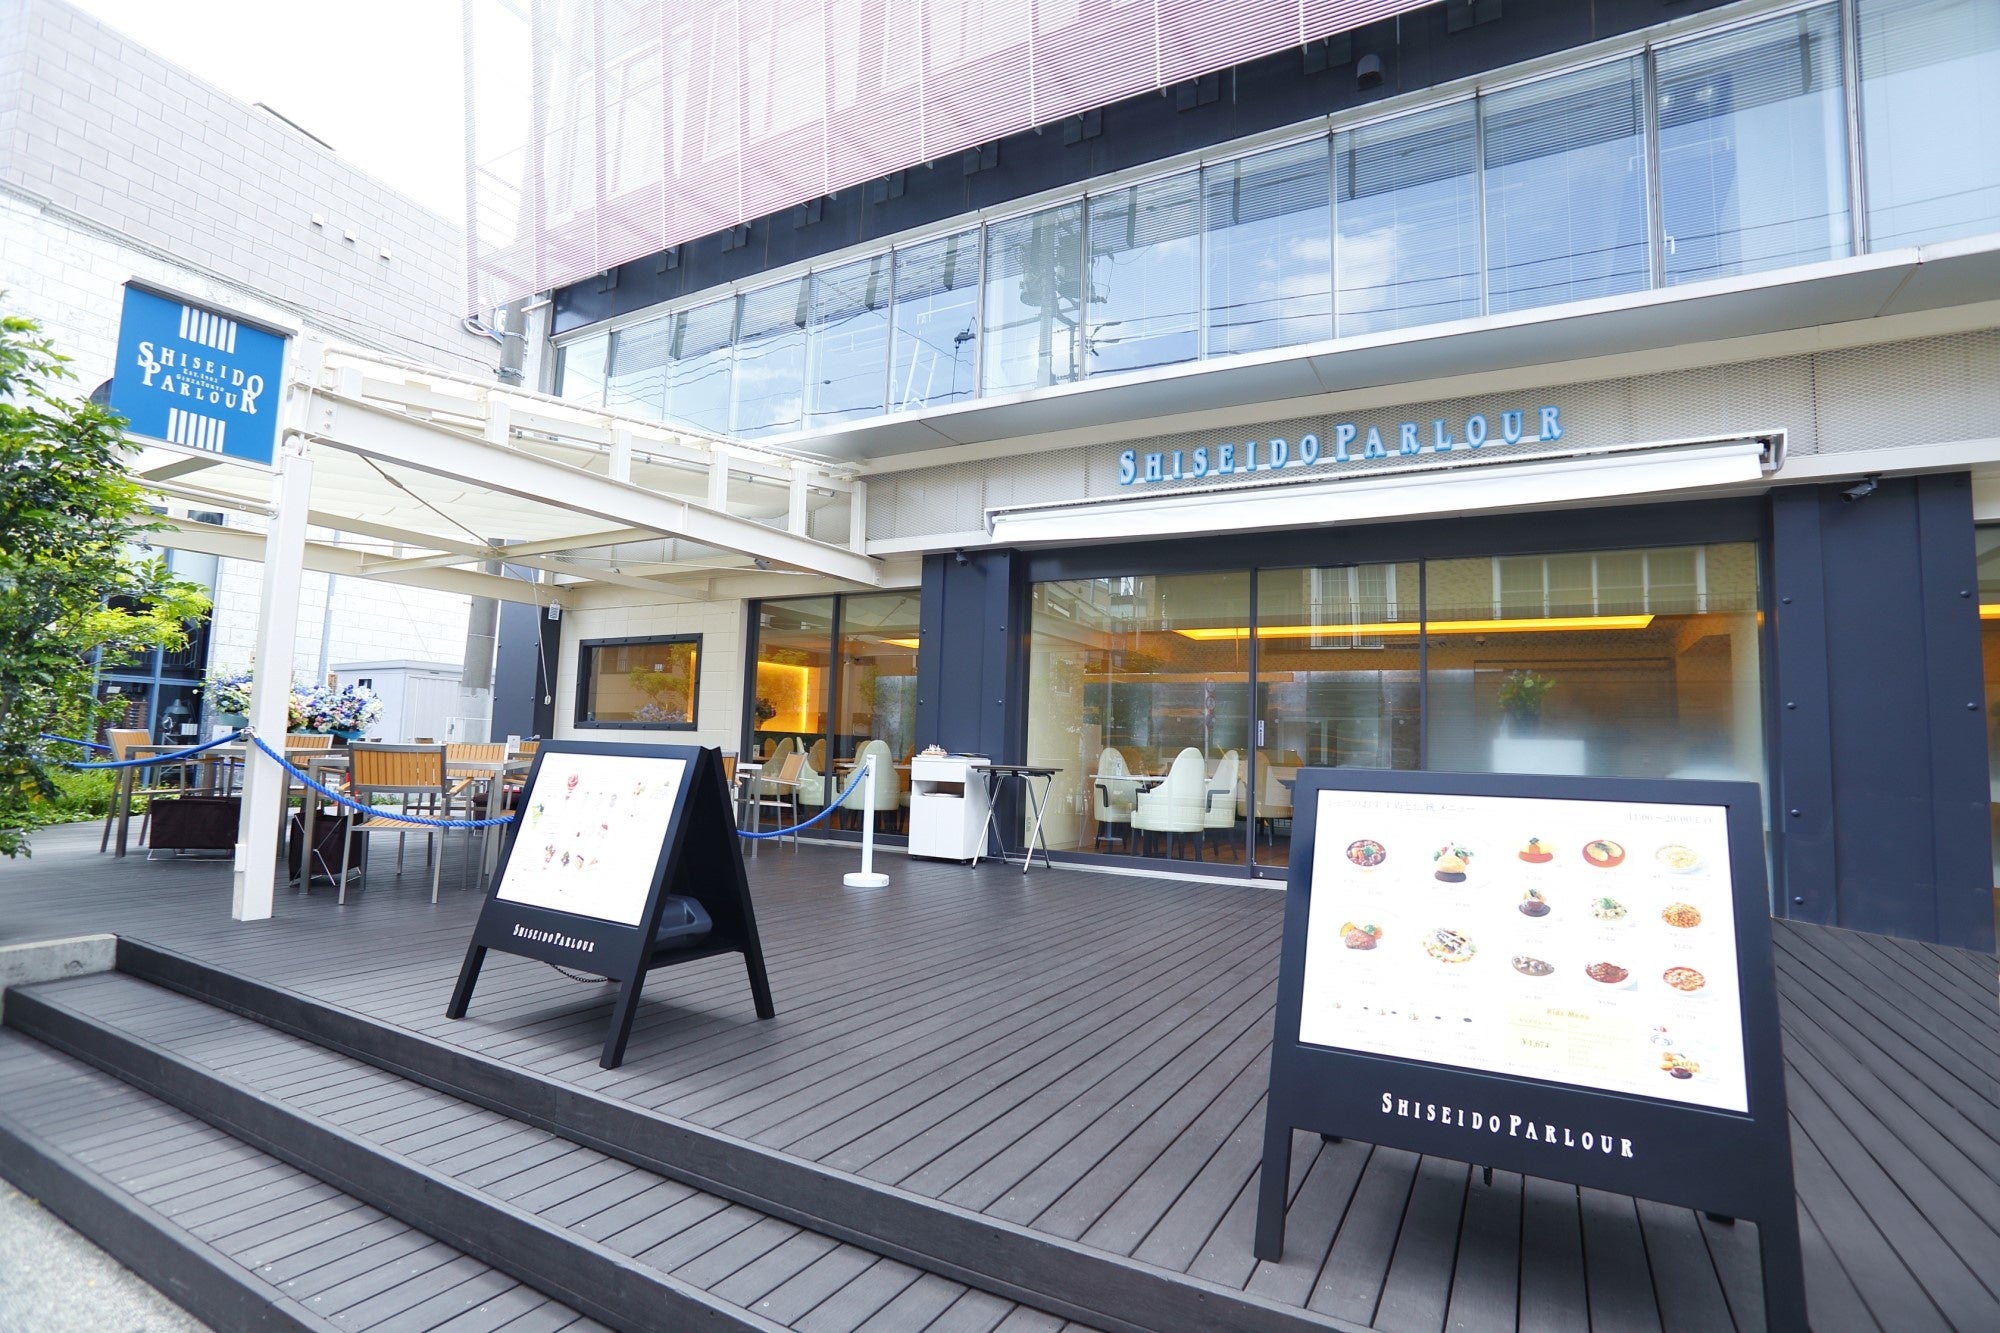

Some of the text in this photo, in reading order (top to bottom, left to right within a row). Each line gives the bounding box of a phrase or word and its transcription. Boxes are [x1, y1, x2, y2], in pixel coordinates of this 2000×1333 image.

[137, 341, 264, 398] SHISEIDO
[141, 361, 258, 415] PARLOUR
[1118, 405, 1565, 486] SHISEIDO PARLOUR
[1381, 1092, 1634, 1158] SHISEIDO PARLOUR
